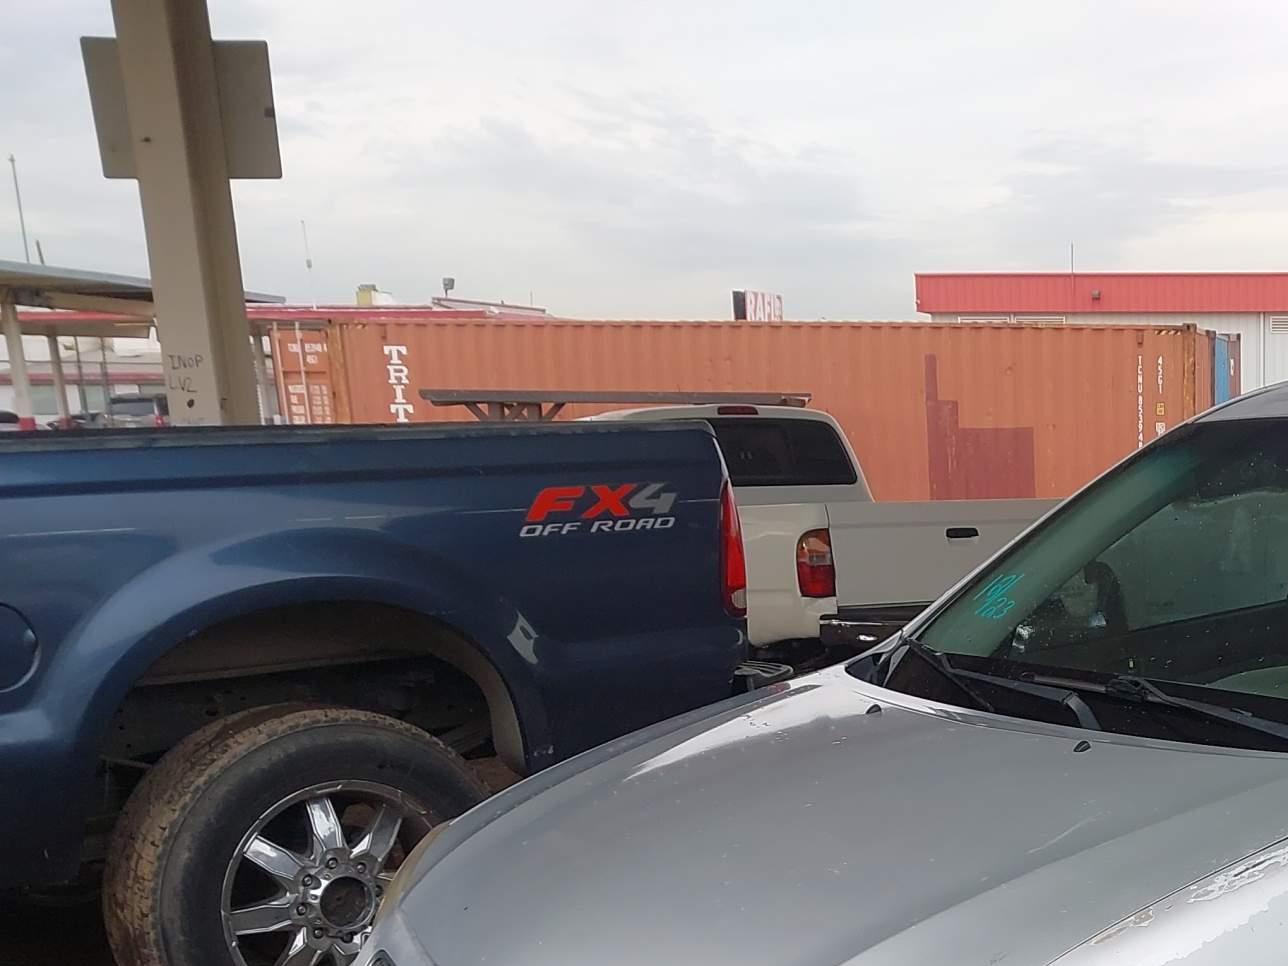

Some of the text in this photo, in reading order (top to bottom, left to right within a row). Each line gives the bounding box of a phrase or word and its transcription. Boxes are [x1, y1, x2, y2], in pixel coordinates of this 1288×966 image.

[168, 354, 204, 370] INOP
[526, 482, 678, 522] FX4
[519, 516, 676, 537] OFF ROAD
